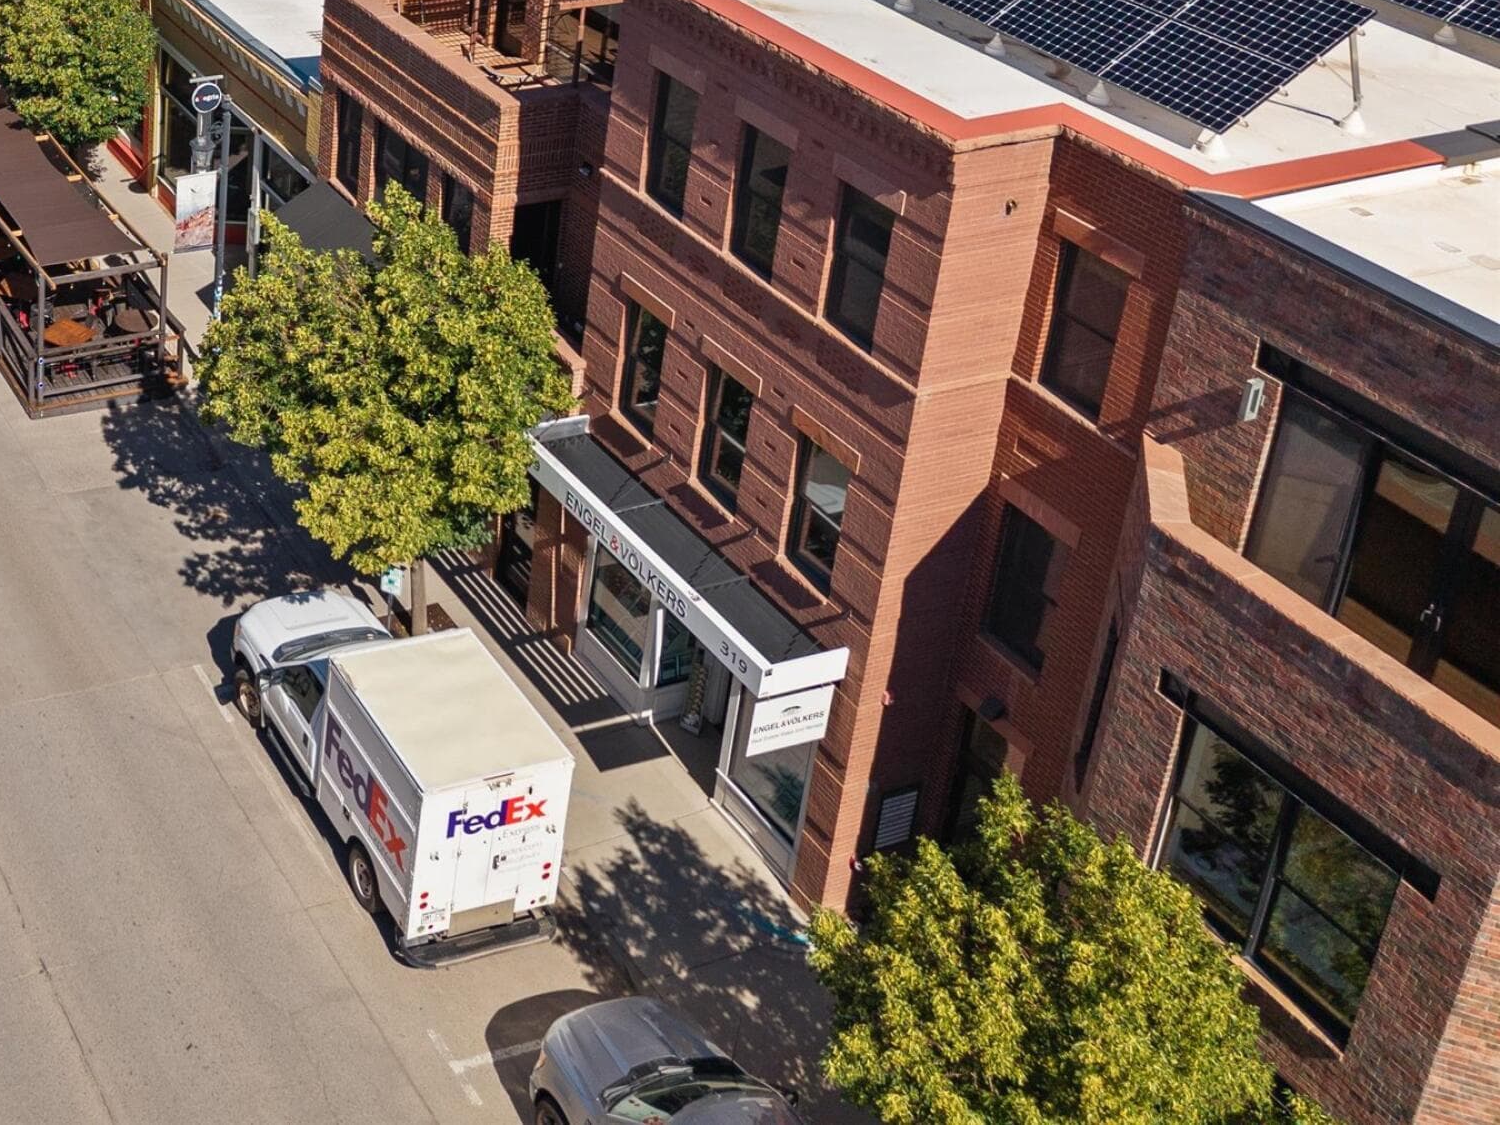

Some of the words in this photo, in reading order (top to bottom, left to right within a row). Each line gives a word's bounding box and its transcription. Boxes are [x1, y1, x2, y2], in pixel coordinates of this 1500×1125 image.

[720, 641, 748, 674] 319
[325, 712, 406, 873] FedEx
[446, 795, 548, 839] FedEx
